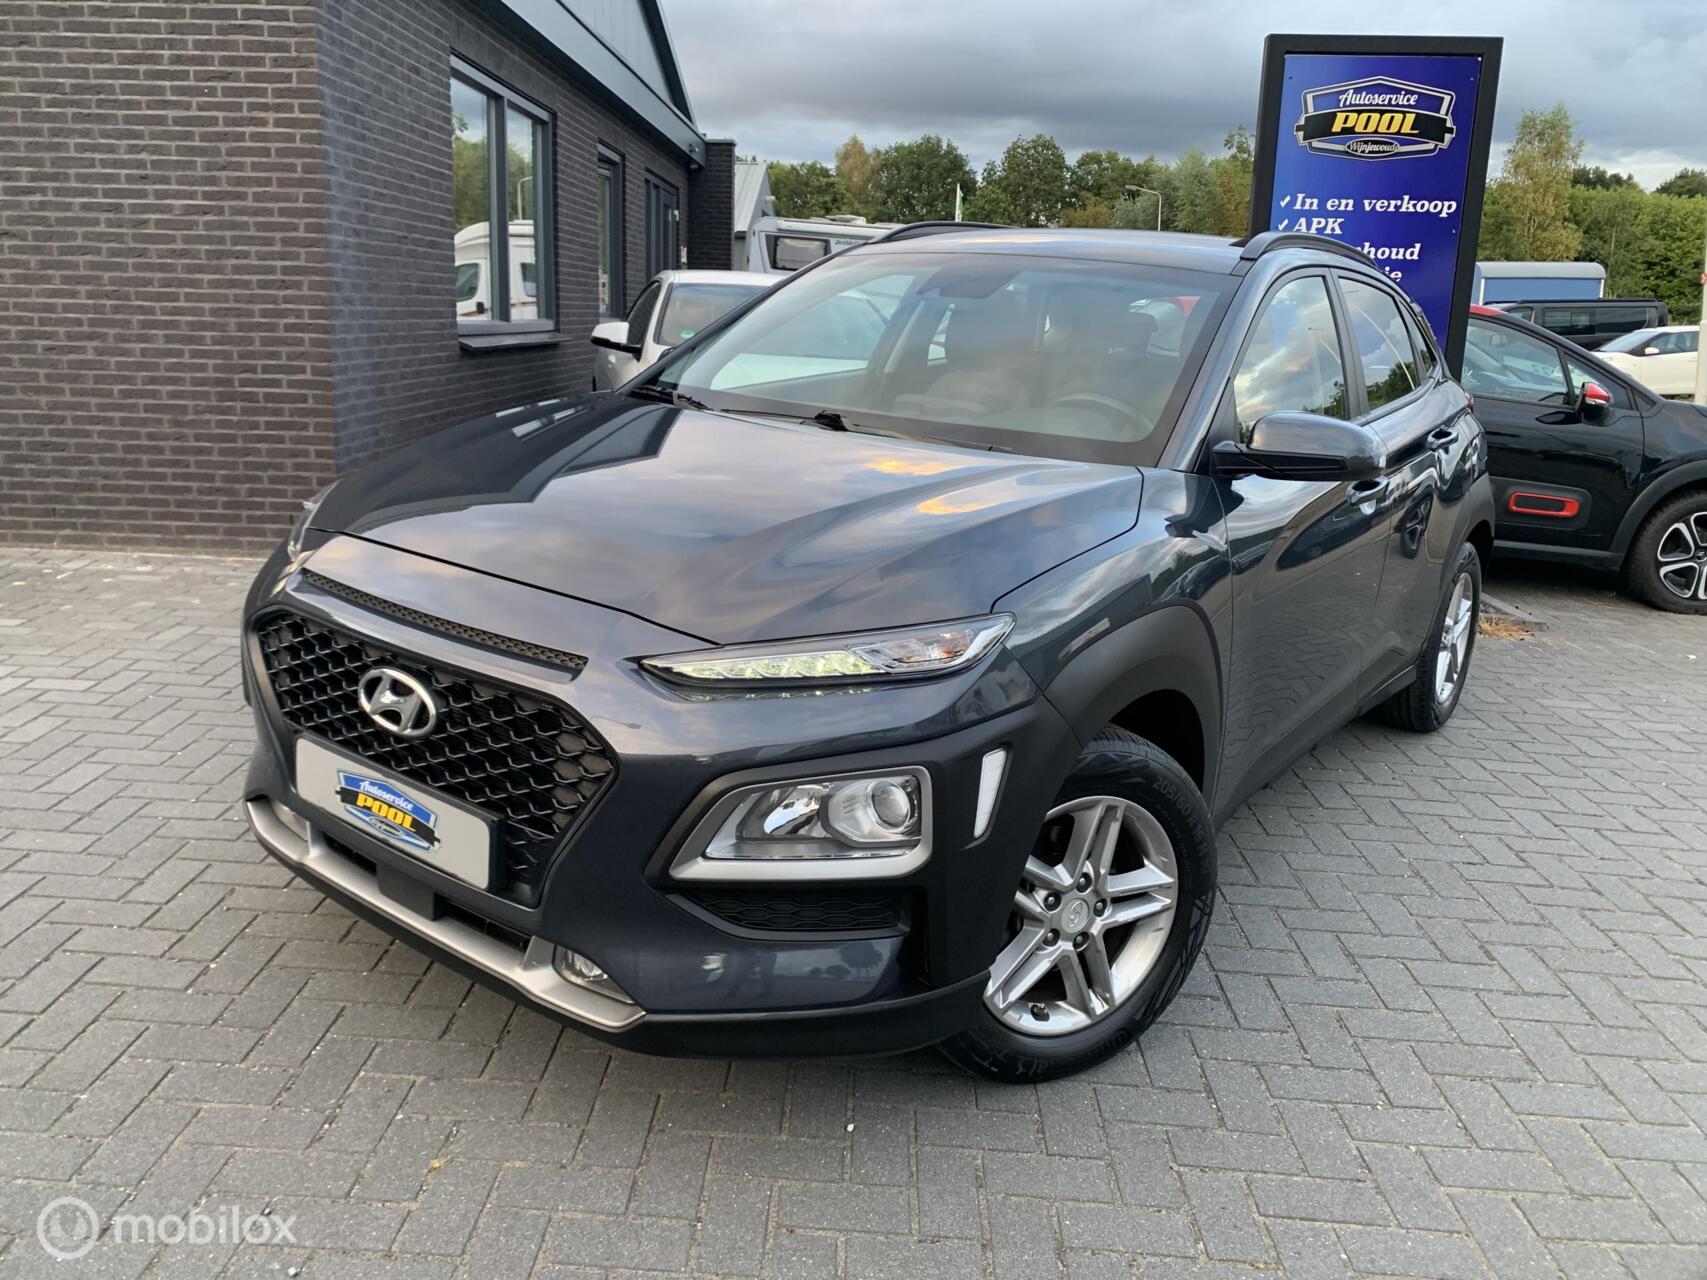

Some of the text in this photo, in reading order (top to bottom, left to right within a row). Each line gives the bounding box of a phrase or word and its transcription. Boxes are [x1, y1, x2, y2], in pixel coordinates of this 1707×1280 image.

[1338, 89, 1419, 108] Autoservice
[1331, 112, 1421, 134] POOL
[1293, 193, 1457, 217] In en verkoop
[1292, 217, 1345, 235] APK
[359, 780, 414, 812] Autoservice
[356, 792, 417, 832] POOL
